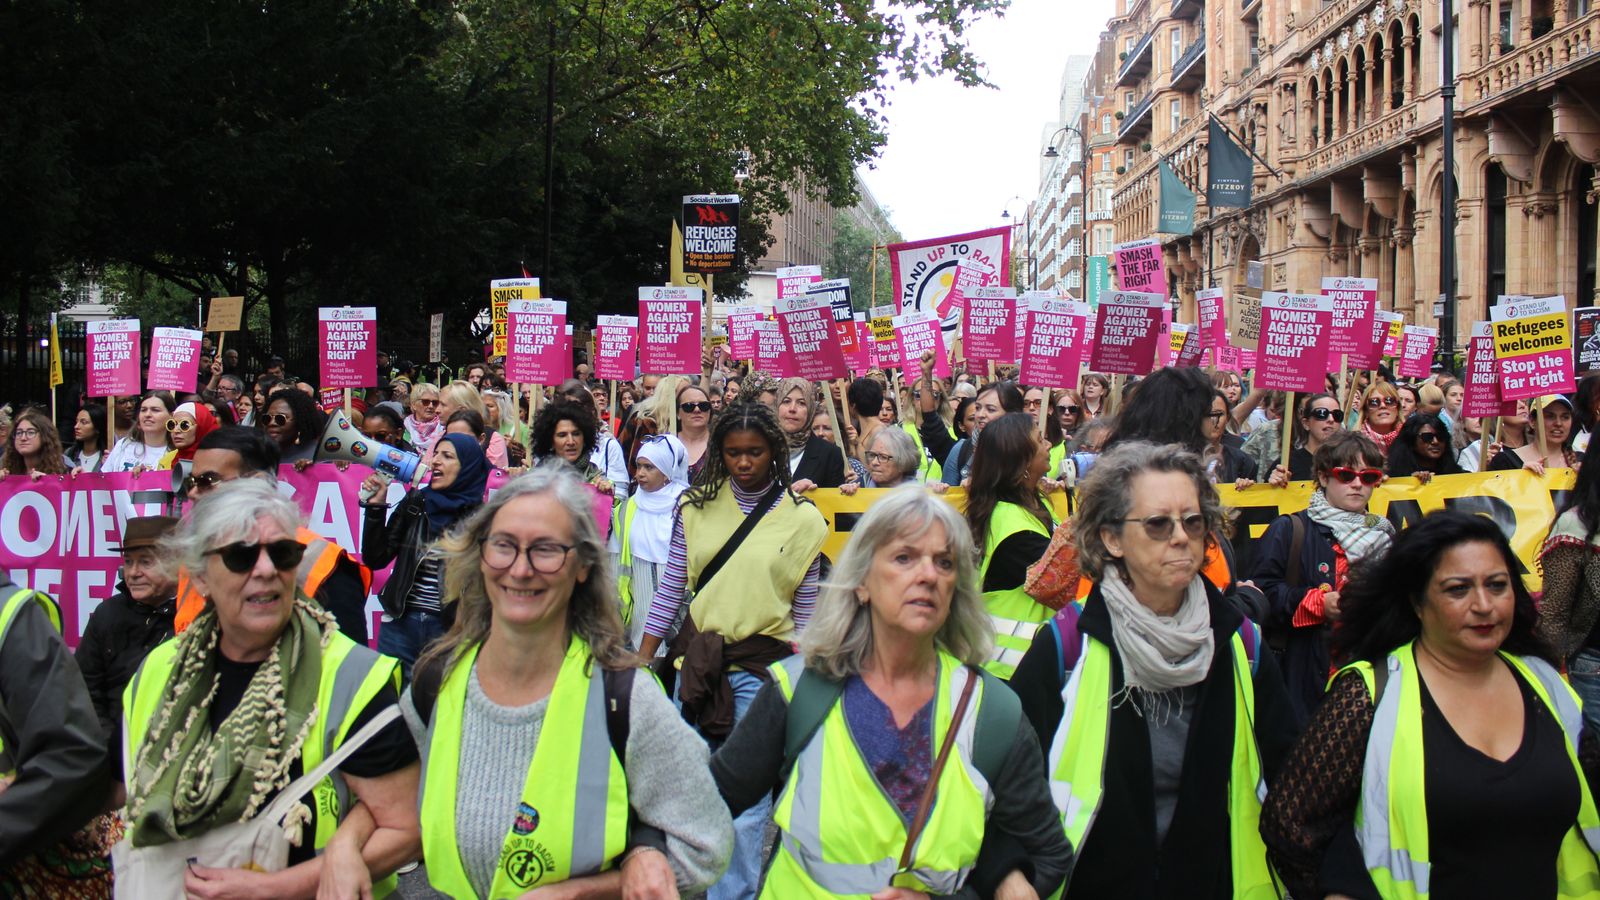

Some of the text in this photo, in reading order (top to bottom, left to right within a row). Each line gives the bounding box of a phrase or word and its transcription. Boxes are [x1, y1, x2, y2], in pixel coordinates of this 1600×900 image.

[1087, 211, 1113, 221] ORTON
[686, 226, 737, 240] REFUGEES
[685, 239, 736, 253] WELCOME
[1120, 248, 1153, 263] SMASH
[1121, 260, 1160, 276] THE FAR
[903, 244, 999, 307] STAND UP TO RACIS
[1124, 273, 1152, 288] RIGHT
[494, 289, 523, 302] SMASH
[1328, 291, 1364, 300] WOMEN
[647, 302, 687, 312] WOMEN
[970, 299, 1004, 308] WOMEN
[1333, 300, 1369, 310] GAINST
[970, 309, 1009, 317] AGAINST
[1107, 306, 1148, 317] WOMEN
[1270, 309, 1316, 323] WOMEN
[1332, 310, 1365, 318] HE FAR
[1528, 307, 1550, 315] RACISM
[515, 314, 552, 324] WOMEN
[647, 313, 693, 322] AGAINST
[784, 310, 821, 323] WOMEN
[970, 317, 1006, 326] THE FAR
[1034, 313, 1073, 326] WOMEN
[326, 321, 364, 331] WOMEN
[788, 320, 828, 333] AGAINST
[1104, 316, 1153, 328] AGAINST
[1332, 319, 1355, 328] IGHT
[495, 323, 501, 335] &
[515, 324, 558, 335] AGAINST
[602, 327, 628, 335] WOMEN
[647, 323, 689, 332] THE FAR
[900, 323, 930, 335] WOMEN
[970, 326, 997, 334] RIGHT
[1033, 324, 1078, 337] AGAINST
[1103, 326, 1147, 338] THE FAR
[1268, 321, 1322, 335] AGAINST
[1497, 318, 1564, 337] Refugees
[93, 333, 128, 342] WOMEN
[327, 331, 369, 340] AGAINST
[601, 334, 632, 342] AGAINST
[647, 333, 679, 343] RIGHT
[790, 332, 809, 343] THE
[810, 330, 828, 340] FAR
[903, 330, 936, 344] AGAINST
[1238, 328, 1260, 340] RACIS
[159, 338, 191, 347] WOMEN
[514, 334, 554, 345] THE FAR
[1032, 334, 1072, 347] THE FAR
[1101, 335, 1135, 346] RIGHT
[1268, 332, 1317, 347] THE FAR
[1406, 340, 1431, 349] AGAINST
[1499, 335, 1563, 352] welcome
[93, 342, 133, 351] AGAINST
[158, 345, 195, 355] AGAINST
[327, 341, 366, 350] THE FAR
[514, 344, 543, 354] RIGHT
[600, 341, 614, 349] THE
[793, 342, 820, 353] RIGHT
[877, 343, 891, 352] Stop
[904, 339, 935, 352] THE FAR
[93, 351, 130, 361] THE FAR
[327, 351, 356, 360] RIGHT
[600, 350, 621, 358] RIGHT
[1030, 345, 1062, 357] RIGHT
[1265, 344, 1303, 358] RIGHT
[175, 354, 191, 363] FAR
[1267, 358, 1288, 366] Reject
[93, 361, 120, 370] RIGHT
[156, 360, 182, 369] RIGHT
[1501, 359, 1536, 374] Stop
[1538, 355, 1564, 369] the
[1266, 373, 1295, 381] Refugees
[1504, 370, 1565, 389] far right
[525, 838, 535, 849] TO
[534, 843, 556, 872] RACISM
